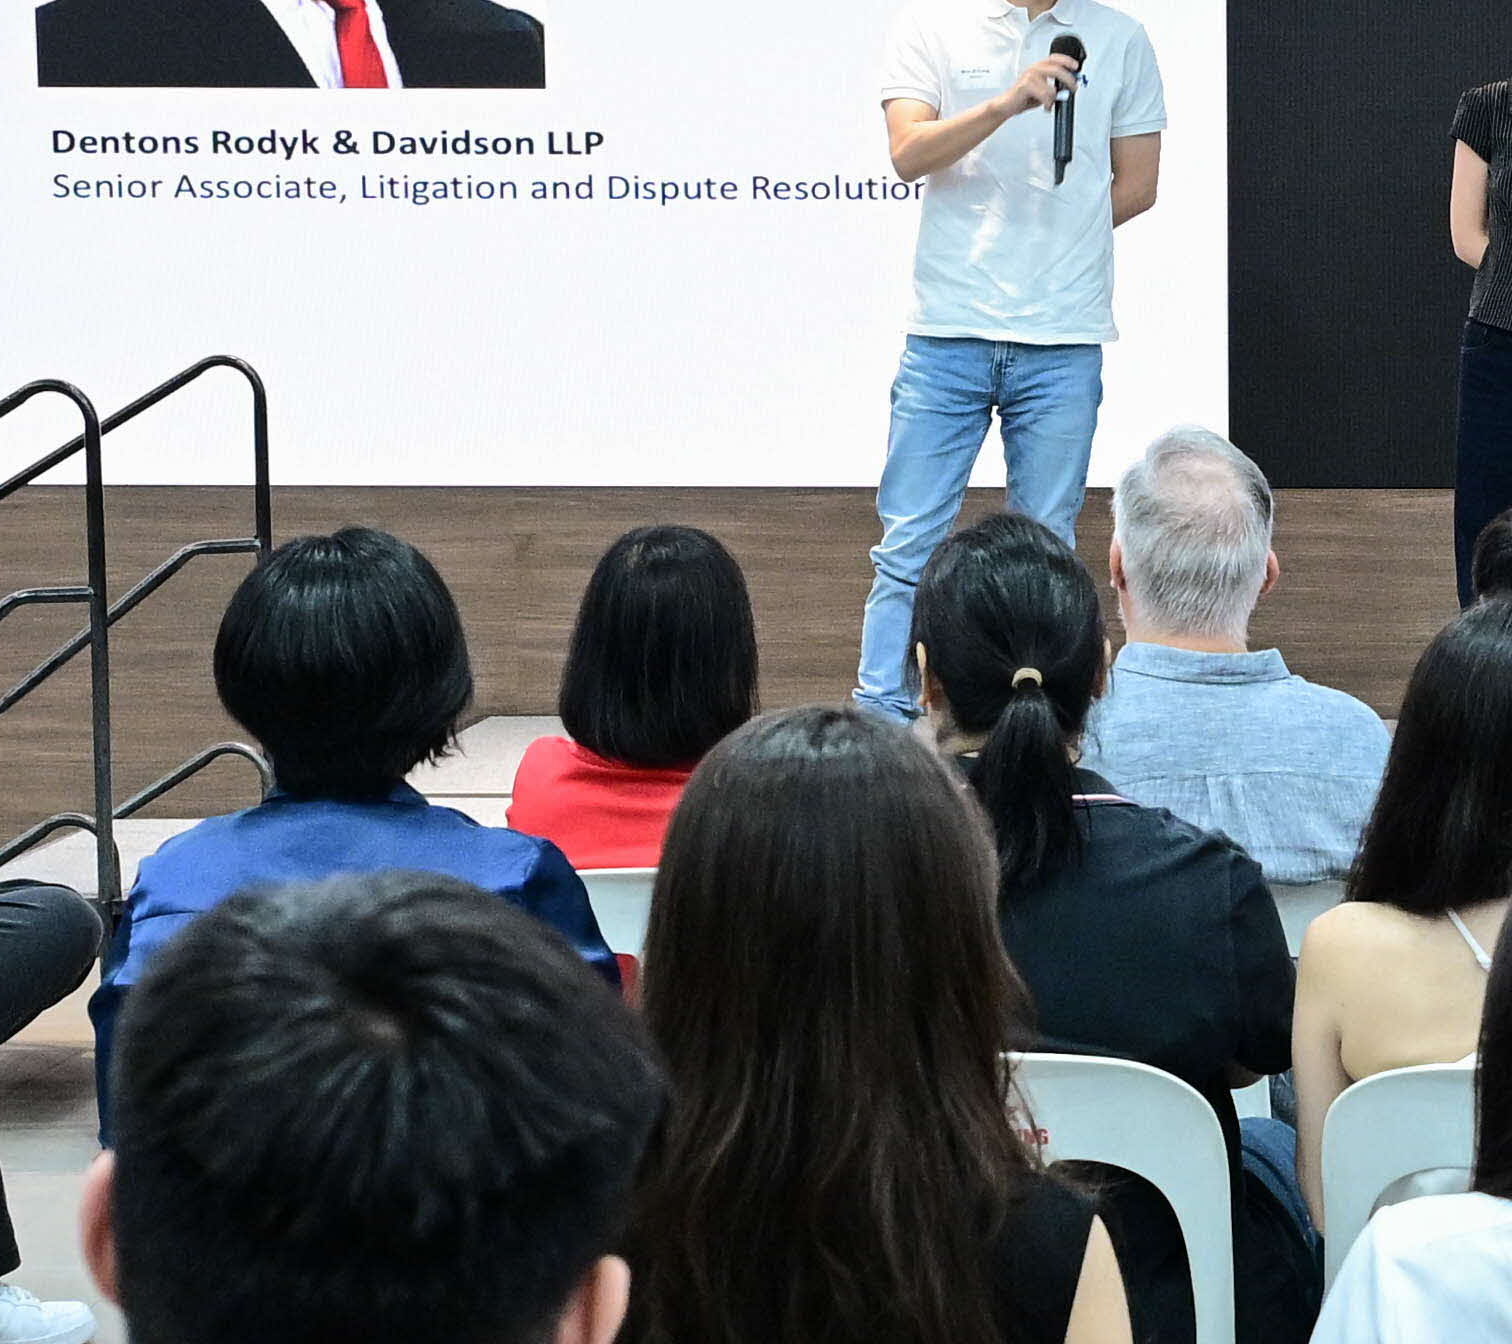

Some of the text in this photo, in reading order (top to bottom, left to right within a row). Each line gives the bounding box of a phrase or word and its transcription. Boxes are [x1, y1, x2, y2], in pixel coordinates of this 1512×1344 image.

[52, 128, 604, 161] Dentons Rodyk & Davidson LLP
[53, 173, 163, 199] Senior
[174, 174, 346, 204] Associate,
[361, 174, 517, 206] Litigation
[531, 174, 593, 200] and
[608, 175, 738, 207] Dispute
